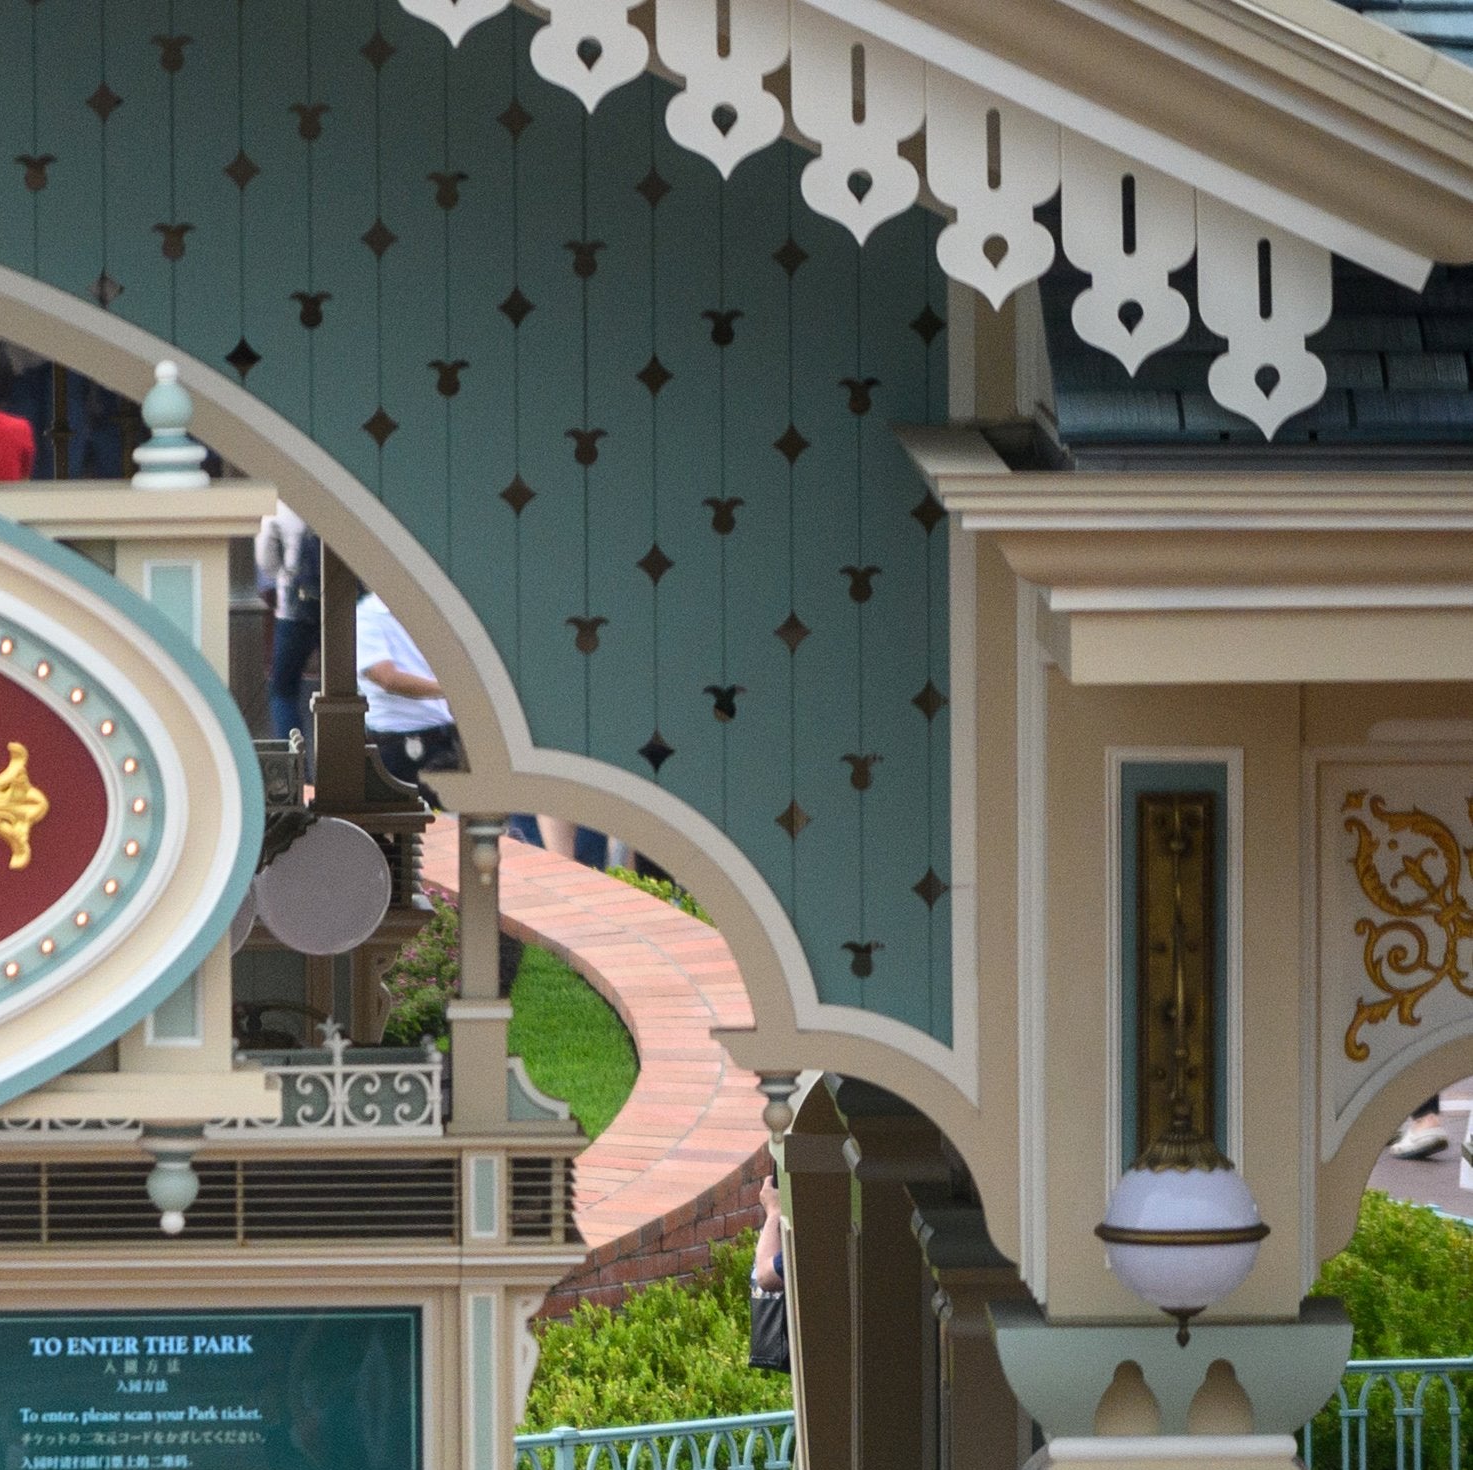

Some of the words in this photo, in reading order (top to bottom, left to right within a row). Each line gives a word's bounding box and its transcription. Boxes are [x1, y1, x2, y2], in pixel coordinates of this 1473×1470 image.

[29, 1337, 63, 1357] TO
[67, 1336, 139, 1356] ENTER
[142, 1335, 189, 1354] THE
[193, 1334, 252, 1353] PARK
[20, 1408, 39, 1423] To
[82, 1406, 121, 1426] please
[123, 1410, 153, 1421] scan
[155, 1409, 186, 1424] your
[188, 1406, 218, 1420] Park
[220, 1405, 262, 1420] ticket.
